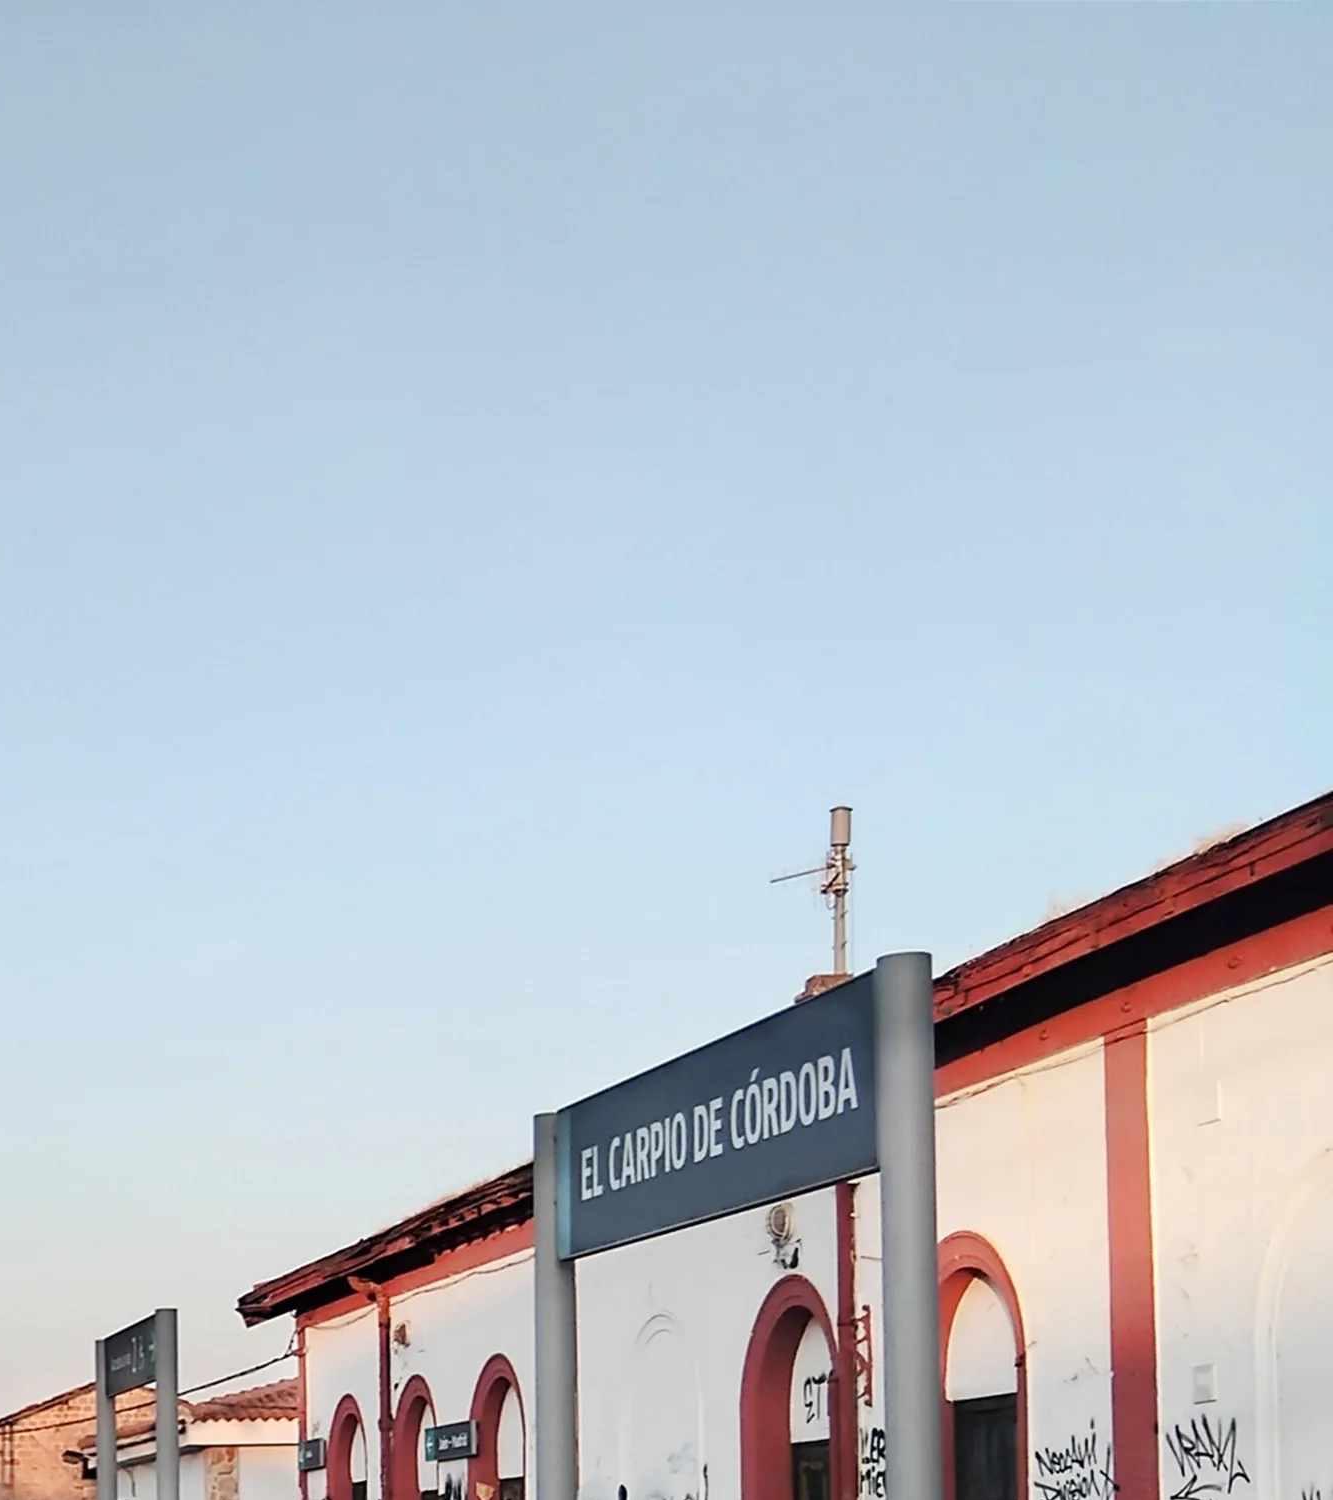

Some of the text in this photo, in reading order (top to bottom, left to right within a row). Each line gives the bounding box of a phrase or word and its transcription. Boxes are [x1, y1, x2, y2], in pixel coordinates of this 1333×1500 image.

[580, 1047, 859, 1201] EL CARPIO DE CÓRDOBA
